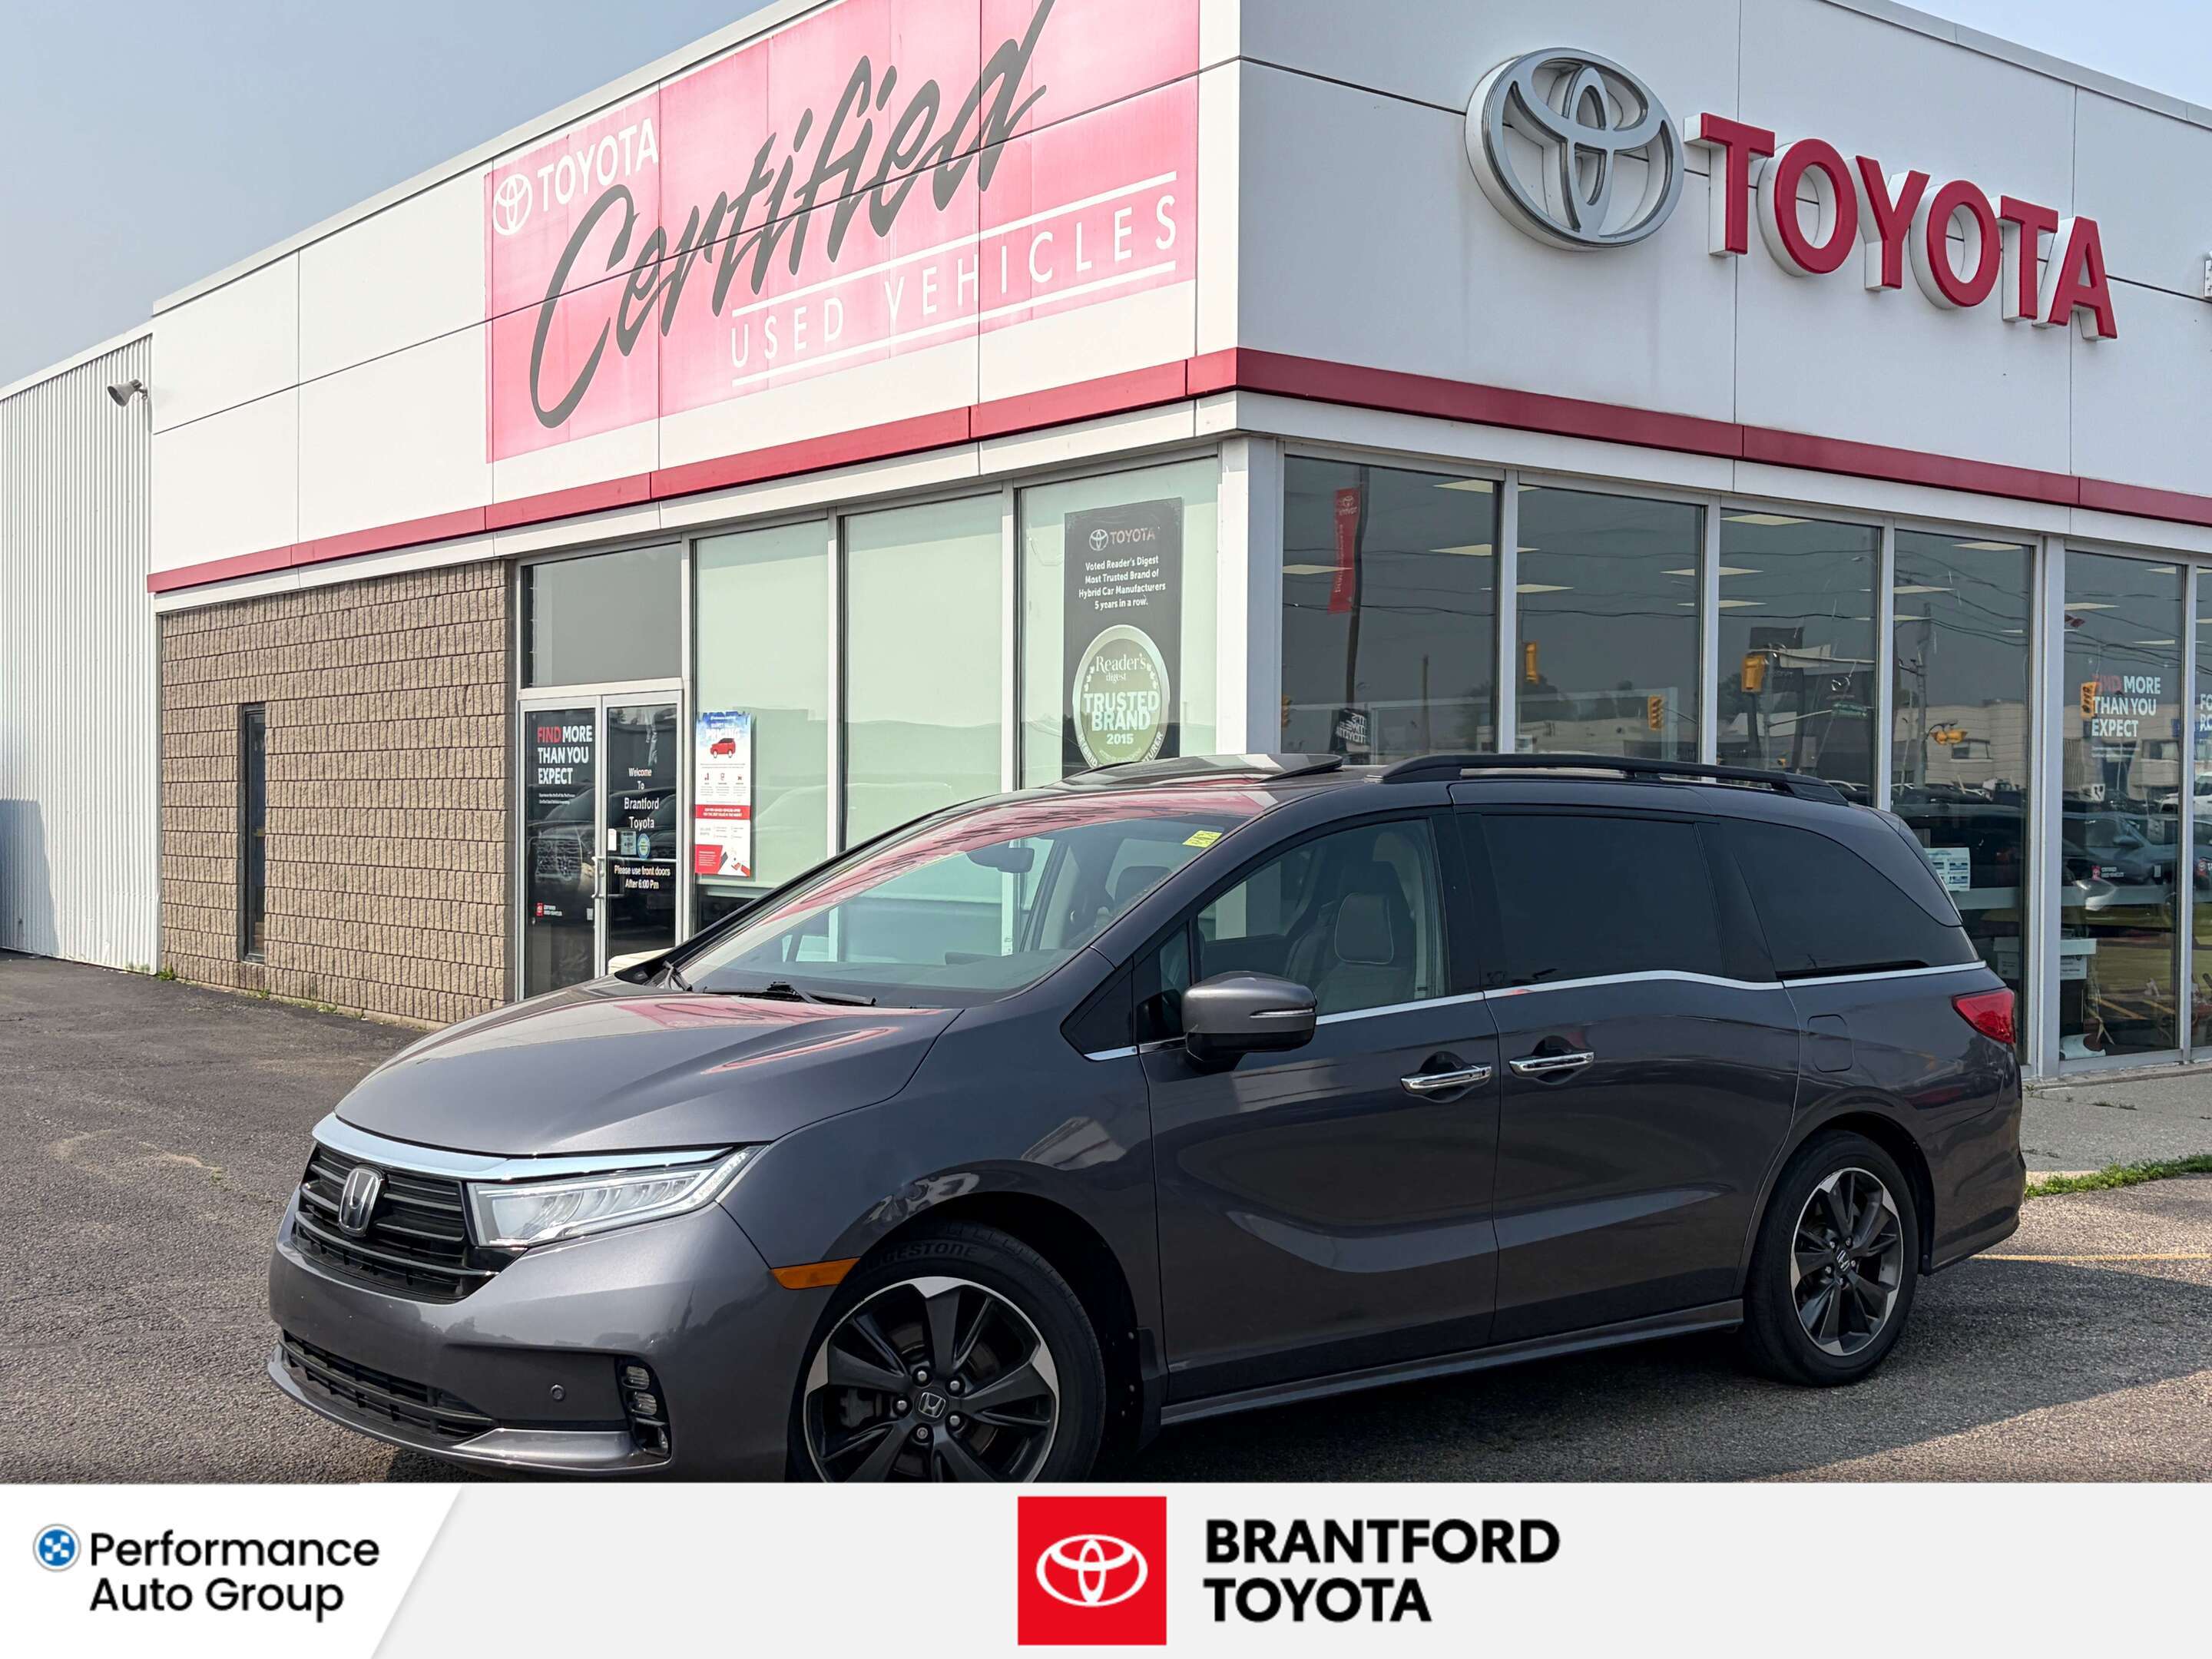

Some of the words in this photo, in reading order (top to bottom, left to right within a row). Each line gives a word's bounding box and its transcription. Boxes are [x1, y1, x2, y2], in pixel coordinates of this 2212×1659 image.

[538, 116, 659, 214] TOYOTA
[530, 0, 1055, 429] Certified
[1685, 112, 2118, 341] TOYOTA
[731, 297, 844, 369] USED
[885, 193, 1177, 323] VEHICLES
[1109, 527, 1156, 545] TOYOTA
[1085, 560, 1105, 571] Voted
[1106, 558, 1135, 569] Reader's
[1137, 555, 1159, 567] Digest
[1085, 574, 1101, 584] Most
[1102, 571, 1128, 583] Trusted
[1130, 569, 1151, 580] Brand
[1151, 568, 1160, 578] of
[1078, 587, 1101, 599] Hybrid
[1102, 586, 1114, 595] Car
[1115, 582, 1166, 594] Manufacturers
[1094, 601, 1099, 610] 5
[1100, 601, 1118, 611] years
[1118, 598, 1126, 608] in
[1133, 598, 1149, 607] row.
[1096, 653, 1147, 674] Reader's
[1106, 672, 1127, 684] digest
[2123, 675, 2161, 694] MORE
[1083, 690, 1161, 714] TRUSTED
[2094, 696, 2128, 715] THAN
[2131, 697, 2157, 716] YOU
[1091, 707, 1151, 732] BRAND
[2091, 718, 2139, 737] EXPECT
[537, 726, 561, 743] FIND
[562, 725, 593, 743] MORE
[1106, 733, 1134, 745] 2015
[537, 747, 565, 764] THAN
[567, 746, 589, 763] YOU
[538, 767, 574, 784] EXPECT
[628, 767, 652, 777] Welcome
[637, 780, 645, 790] To
[624, 796, 660, 810] Brantford
[628, 816, 655, 832] Toyota
[614, 865, 631, 875] Please
[641, 866, 654, 876] front
[655, 866, 671, 876] doors
[625, 879, 638, 888] After
[650, 879, 660, 889] Pm
